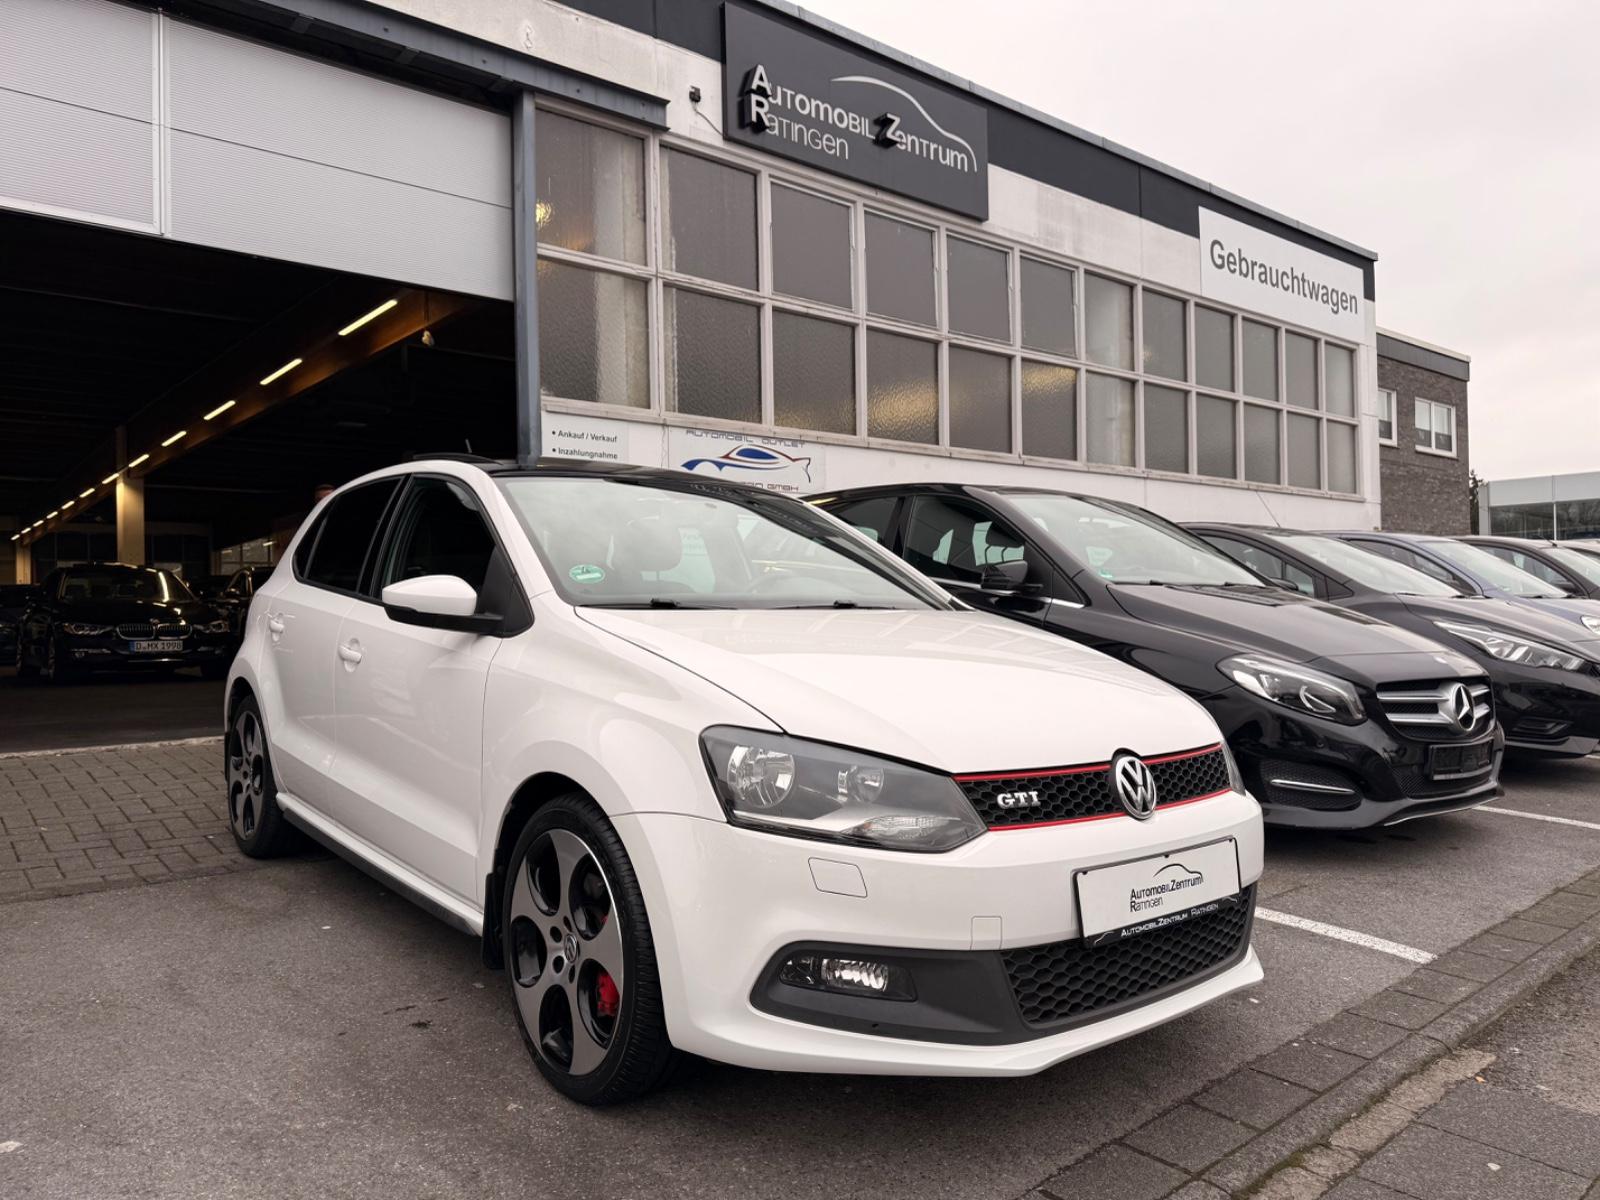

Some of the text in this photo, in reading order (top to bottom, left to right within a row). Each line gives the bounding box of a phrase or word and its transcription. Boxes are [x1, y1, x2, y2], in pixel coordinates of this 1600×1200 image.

[1210, 239, 1358, 314] Gebrauchtwagen
[558, 430, 584, 440] Ankauf
[590, 433, 617, 442] Verkauf
[686, 429, 806, 448] AUTOMOBIL OUTLET
[558, 448, 617, 459] Inzahlungnahme
[997, 791, 1042, 809] GTI
